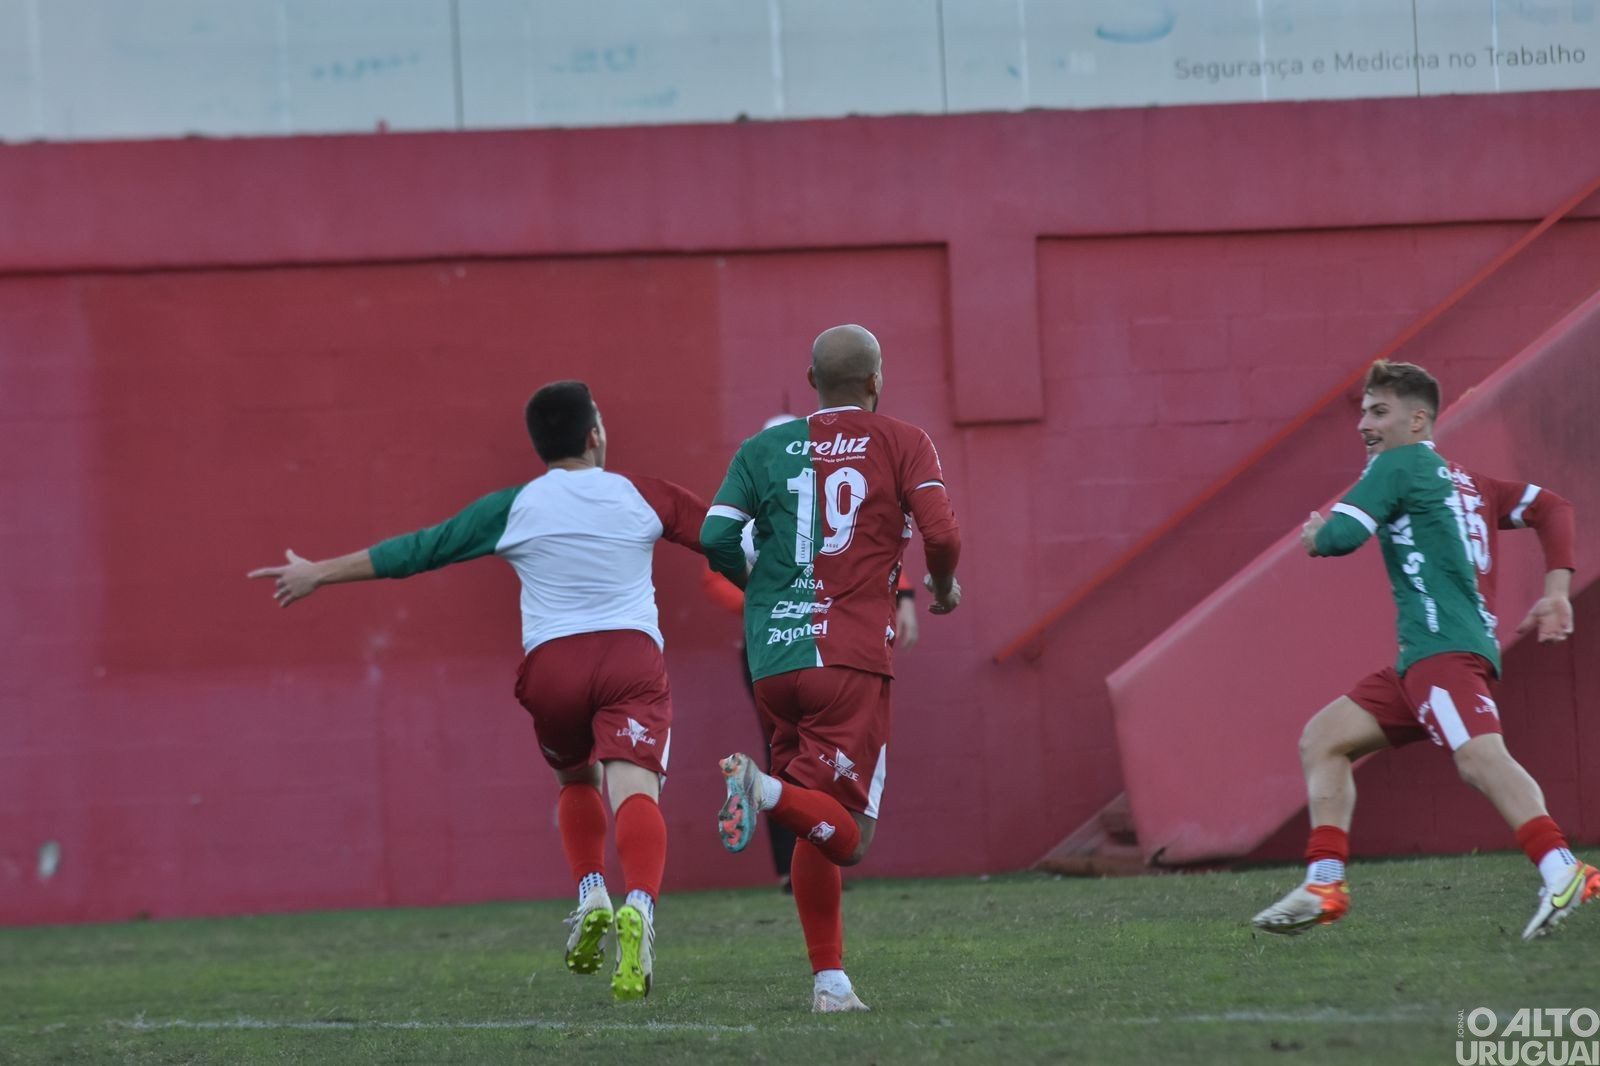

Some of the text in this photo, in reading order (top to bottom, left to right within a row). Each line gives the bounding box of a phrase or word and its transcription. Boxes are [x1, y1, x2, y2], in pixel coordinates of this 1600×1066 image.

[1174, 45, 1587, 84] Segurança e Medicina no Trabalho
[785, 432, 871, 456] creluz
[787, 467, 869, 566] 19
[767, 620, 828, 646] Zagonel
